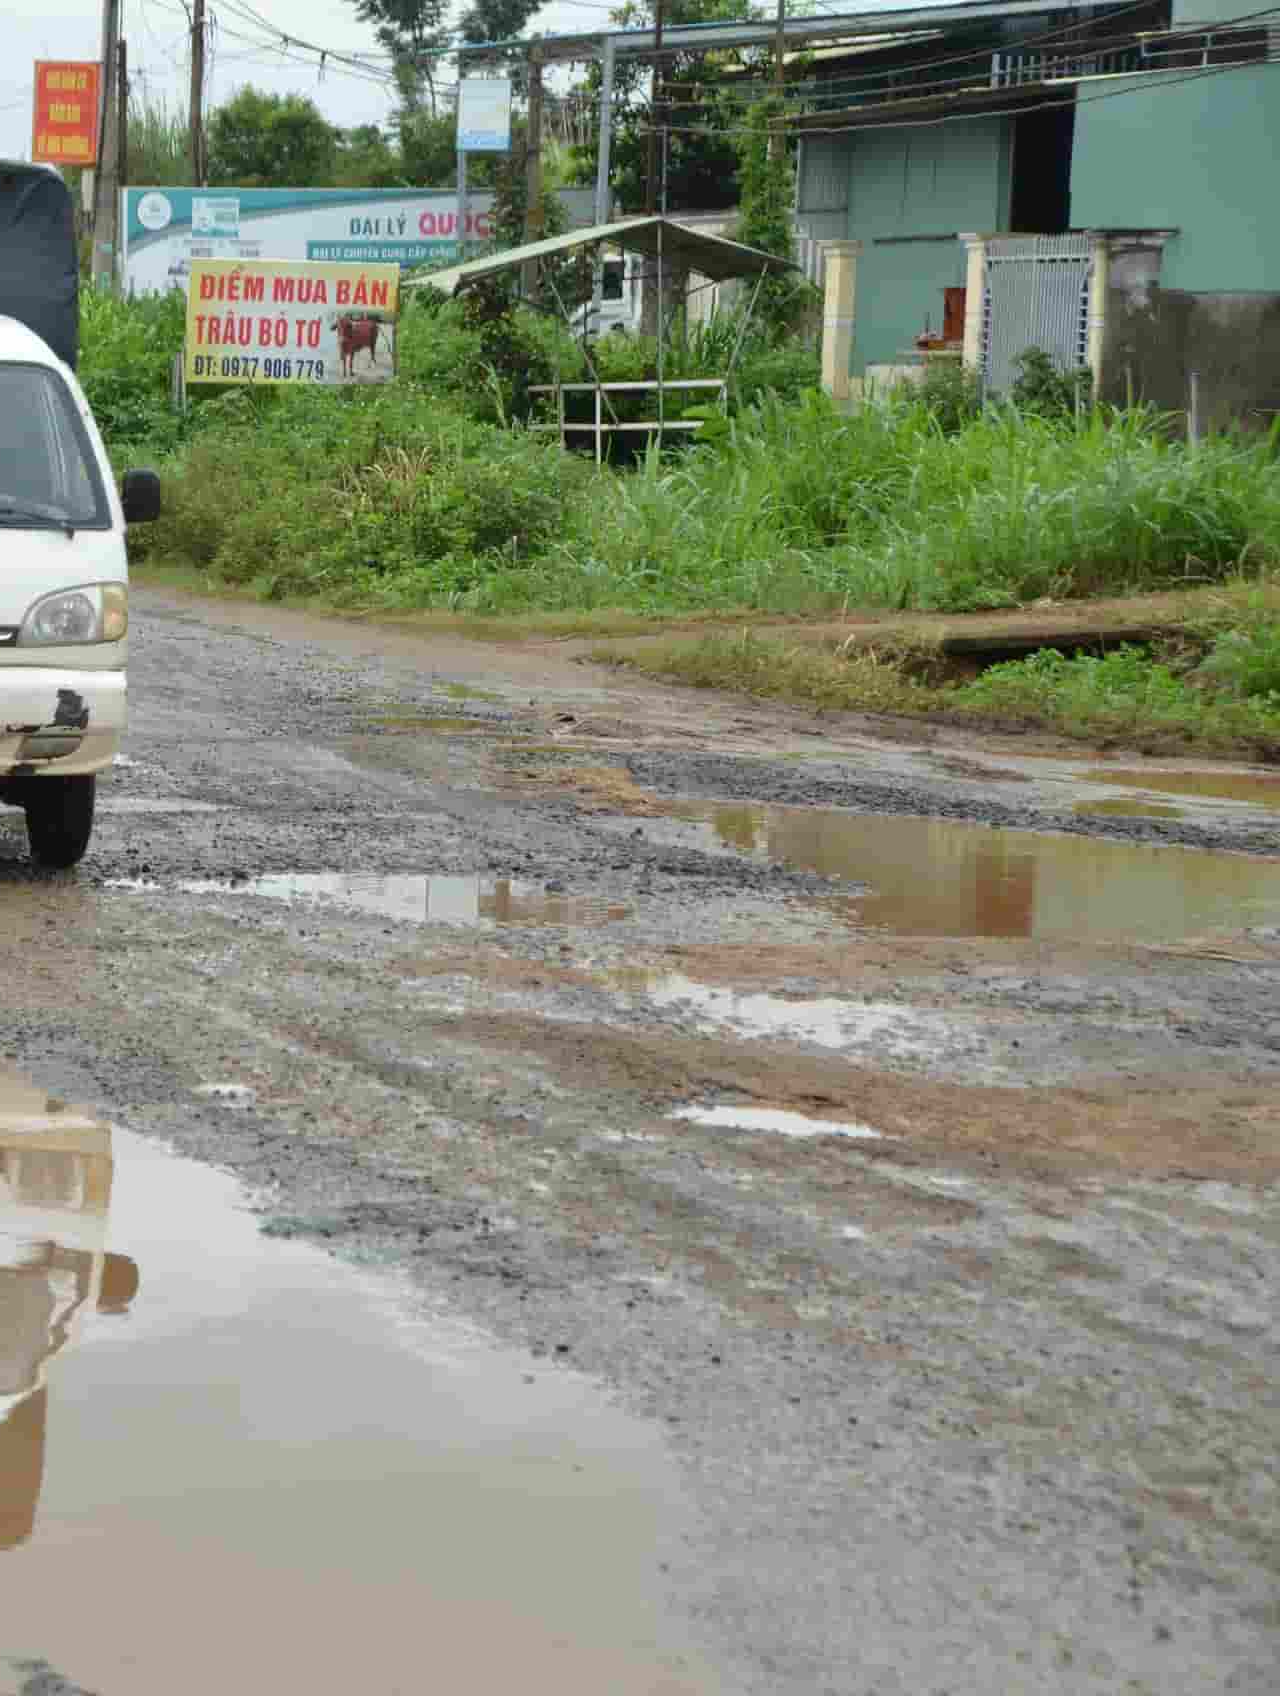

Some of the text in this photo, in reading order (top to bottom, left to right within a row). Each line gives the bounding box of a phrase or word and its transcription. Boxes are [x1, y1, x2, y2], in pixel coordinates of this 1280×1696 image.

[200, 264, 264, 301] ĐIỂM
[272, 275, 327, 304] MUA
[336, 272, 389, 305] BÁN
[195, 309, 253, 345] TRÂU
[222, 355, 259, 377] 0977
[264, 357, 290, 379] 906
[297, 359, 324, 380] 779
